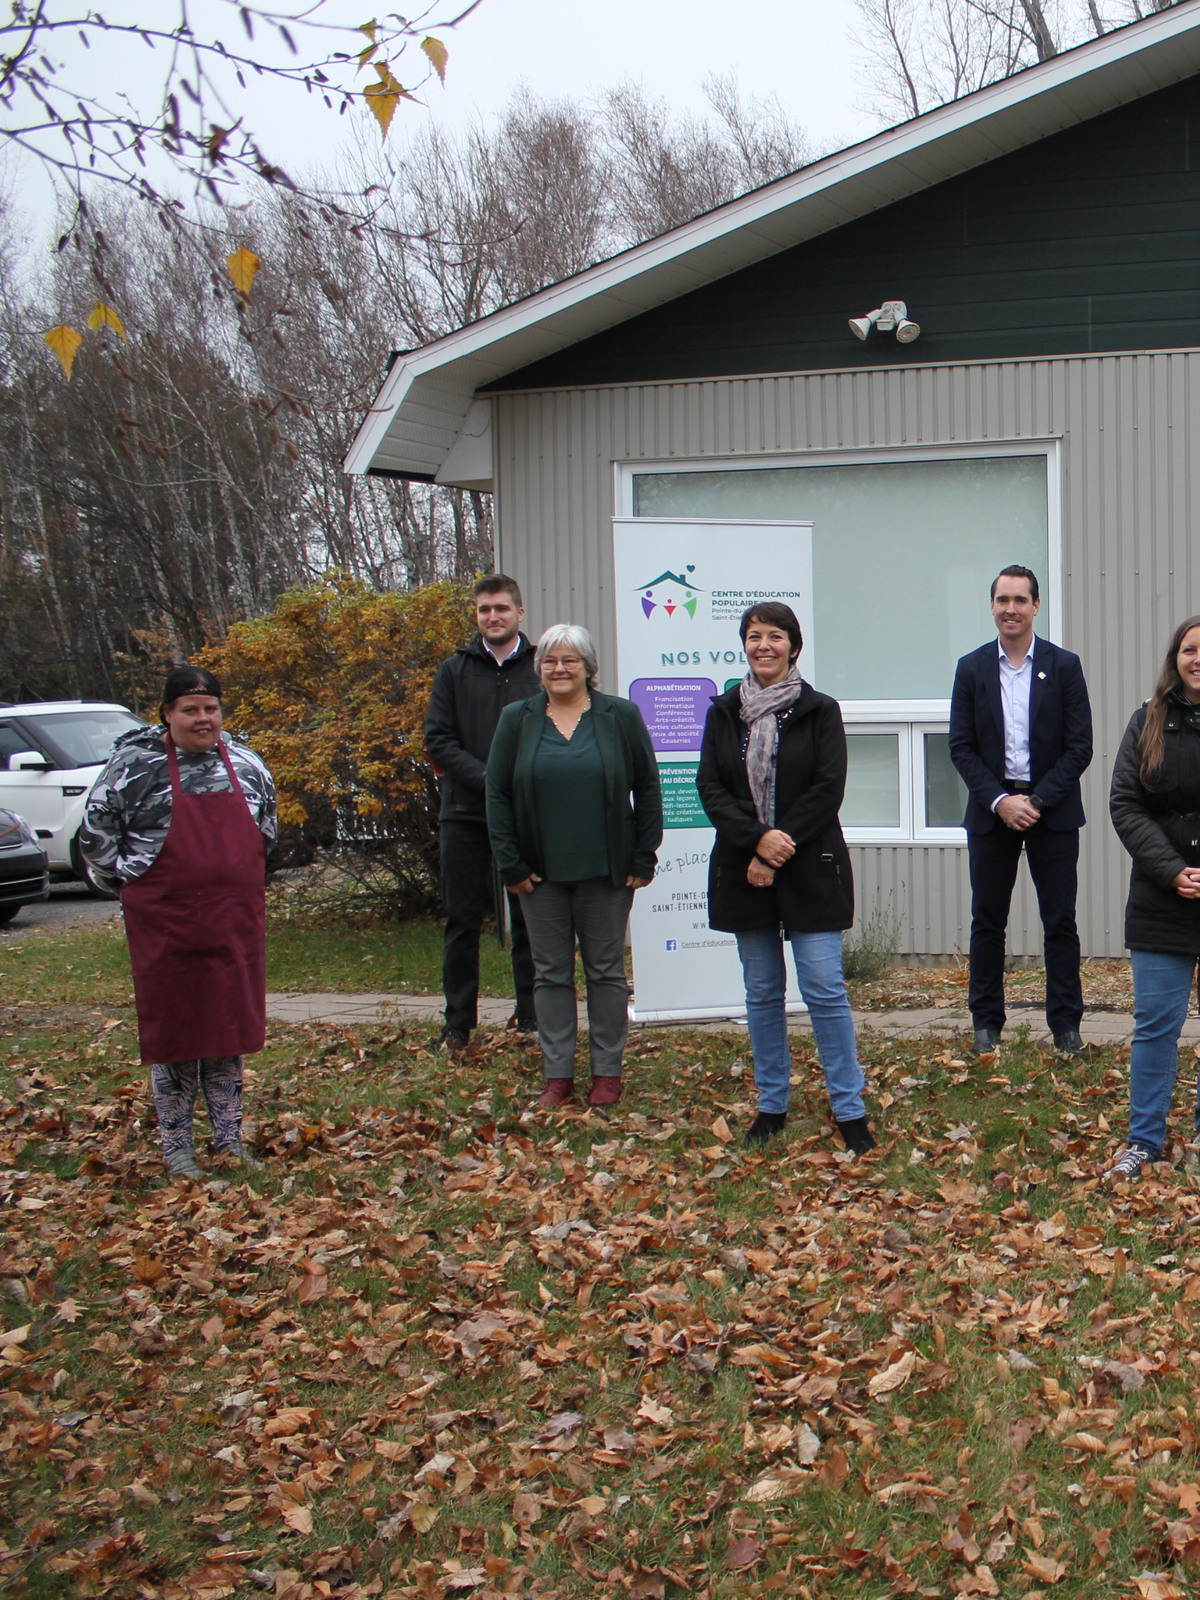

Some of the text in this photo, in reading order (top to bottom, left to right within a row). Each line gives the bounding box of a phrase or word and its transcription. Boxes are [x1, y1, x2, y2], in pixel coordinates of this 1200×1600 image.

[711, 589, 801, 598] CENTRE D'ÉDUCATION
[661, 650, 746, 666] NOS VOL
[646, 684, 701, 692] ALPHABÉTISATION
[673, 776, 697, 784] DÉCROC
[676, 795, 696, 803] leçons
[654, 852, 708, 878] ne plac
[671, 891, 708, 901] POINTE-D
[652, 902, 708, 913] SAINT-ÉTIENNE
[681, 941, 700, 949] Centre
[701, 939, 735, 947] d'éducation
